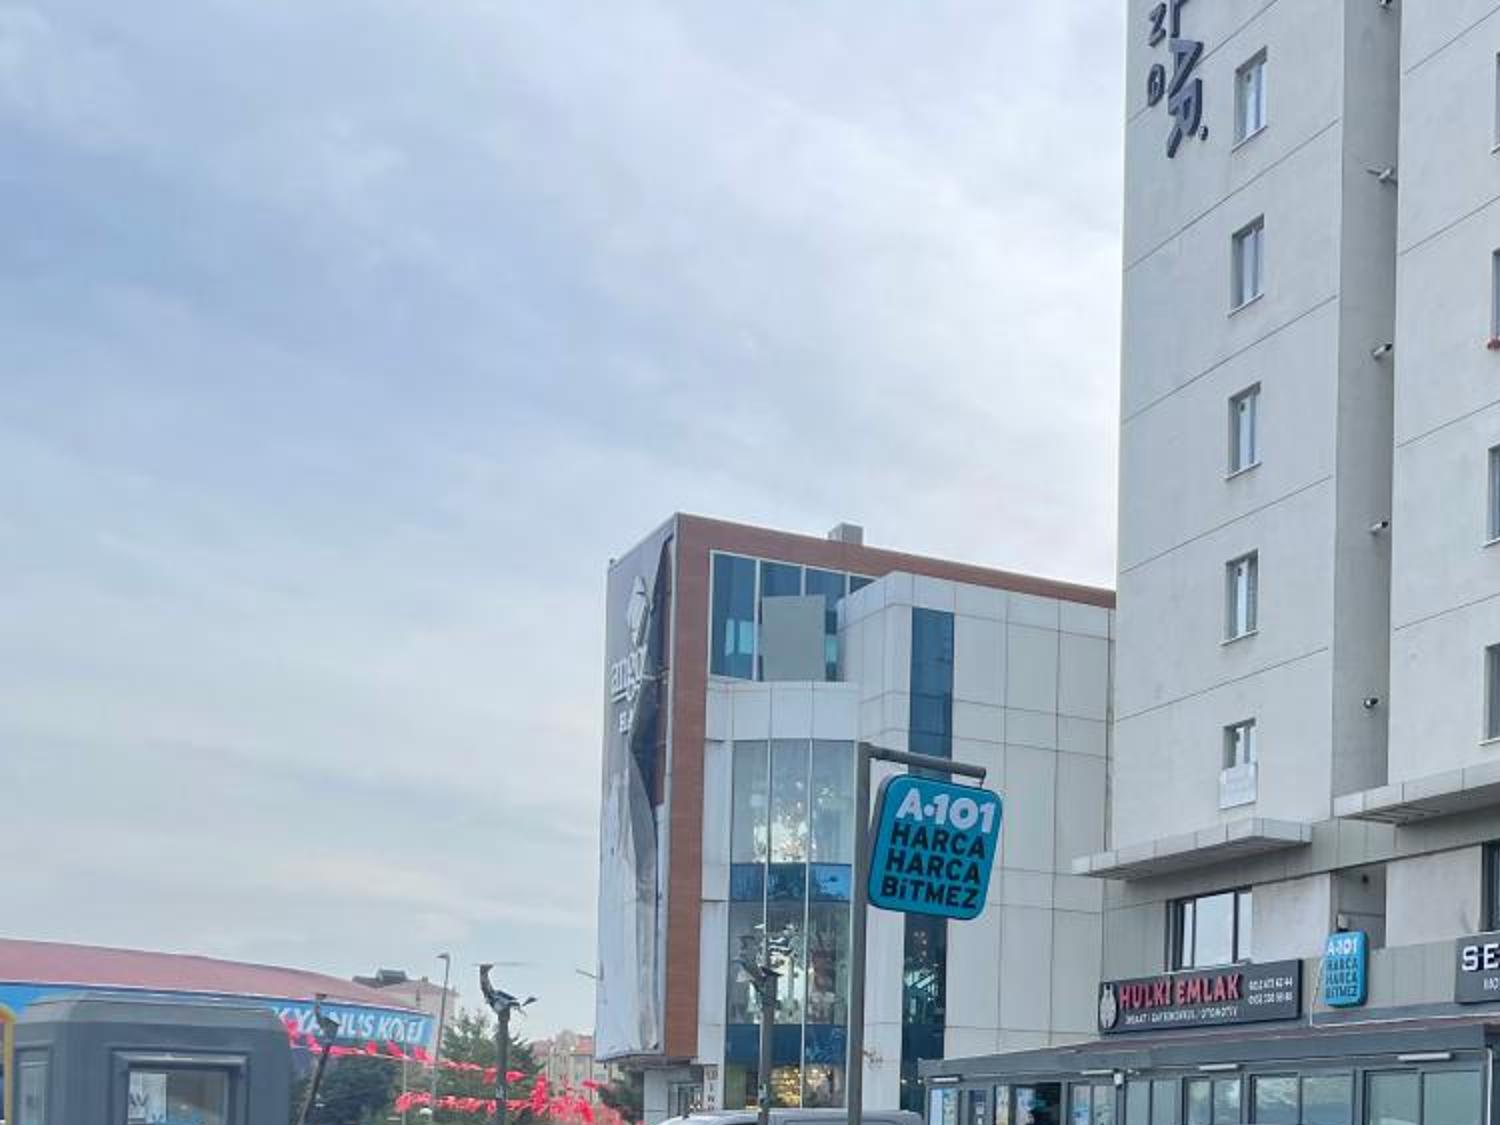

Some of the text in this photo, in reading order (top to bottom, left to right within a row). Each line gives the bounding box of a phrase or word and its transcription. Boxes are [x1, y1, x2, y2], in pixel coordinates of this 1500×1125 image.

[891, 820, 985, 859] HARCA
[885, 847, 982, 887] HARCA
[1177, 973, 1239, 1006] EMLAK
